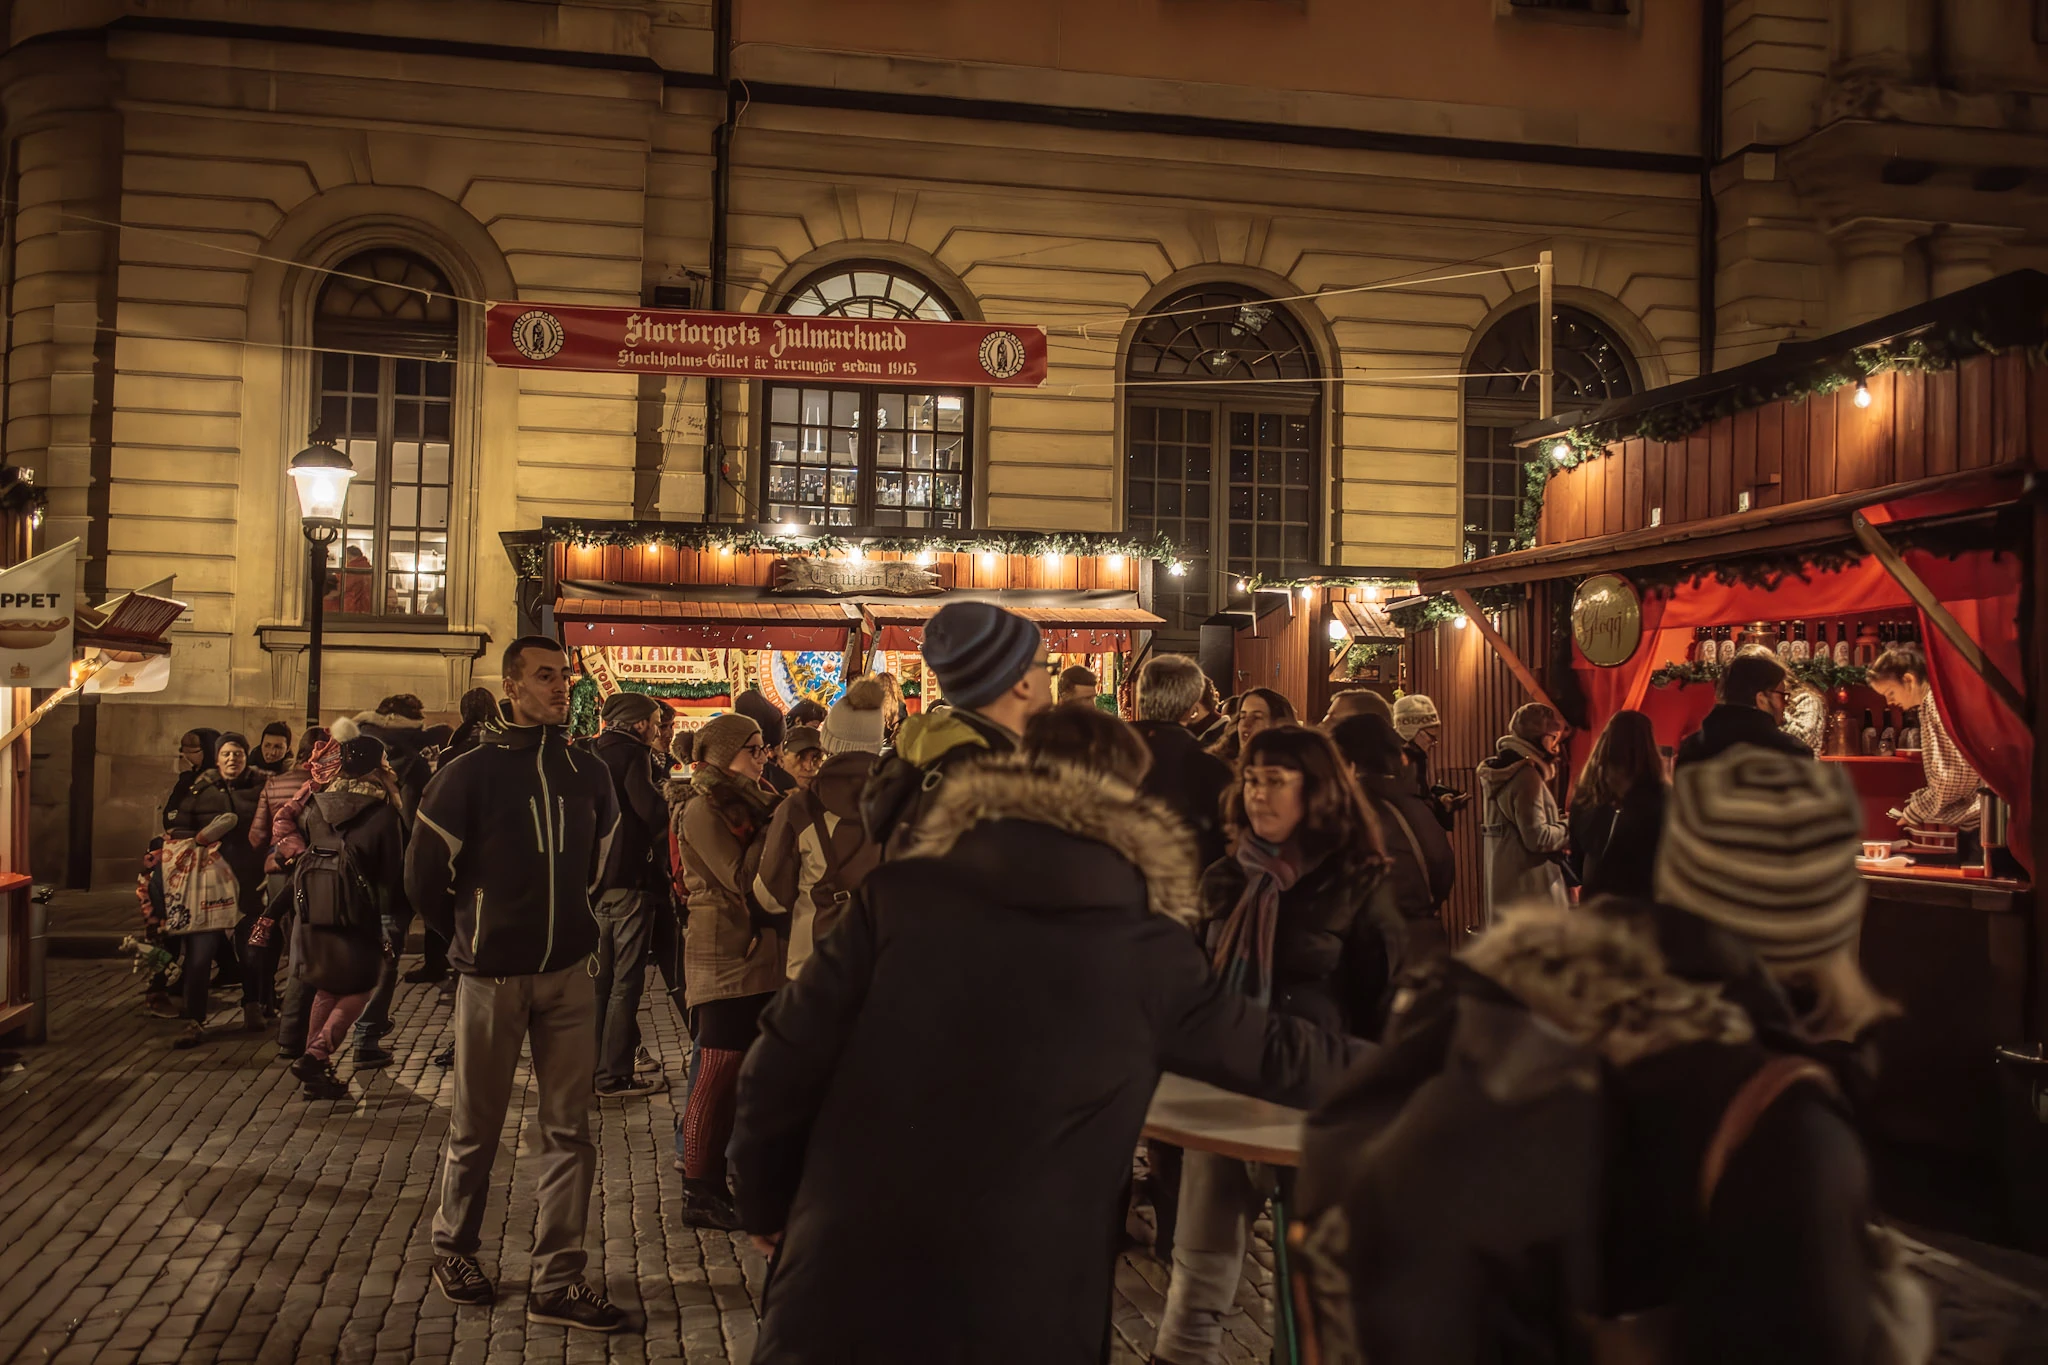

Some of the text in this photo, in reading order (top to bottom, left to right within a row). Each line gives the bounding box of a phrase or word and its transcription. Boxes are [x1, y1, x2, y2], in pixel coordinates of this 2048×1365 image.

[624, 313, 906, 358] Stortorgets Julmarknad
[754, 356, 769, 370] är
[774, 358, 836, 374] arrangör
[842, 359, 882, 374] sedan
[888, 361, 918, 375] 1915
[618, 662, 694, 675] TOBLERONE
